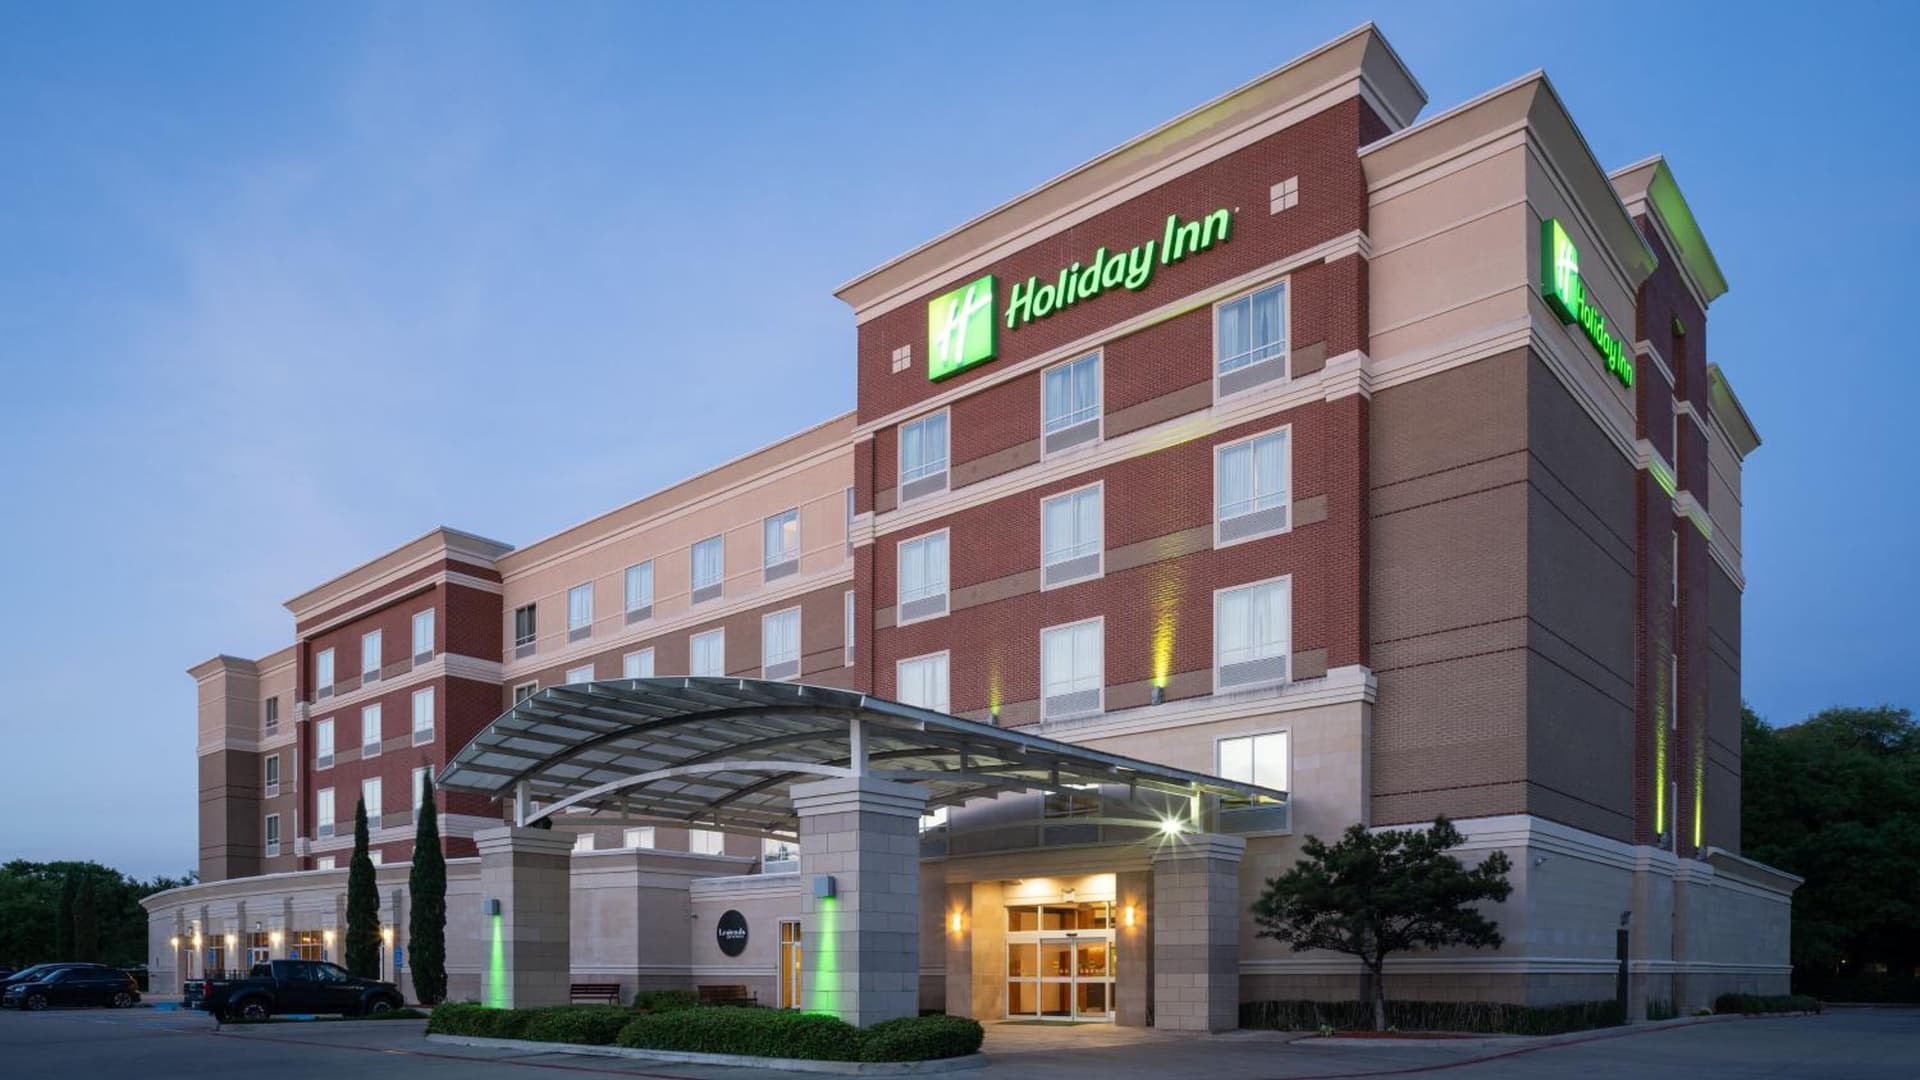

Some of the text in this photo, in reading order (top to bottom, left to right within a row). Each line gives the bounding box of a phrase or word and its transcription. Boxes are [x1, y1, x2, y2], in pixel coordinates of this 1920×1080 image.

[1005, 207, 1233, 329] Holiday Inn
[1577, 279, 1634, 387] Holiday Inn
